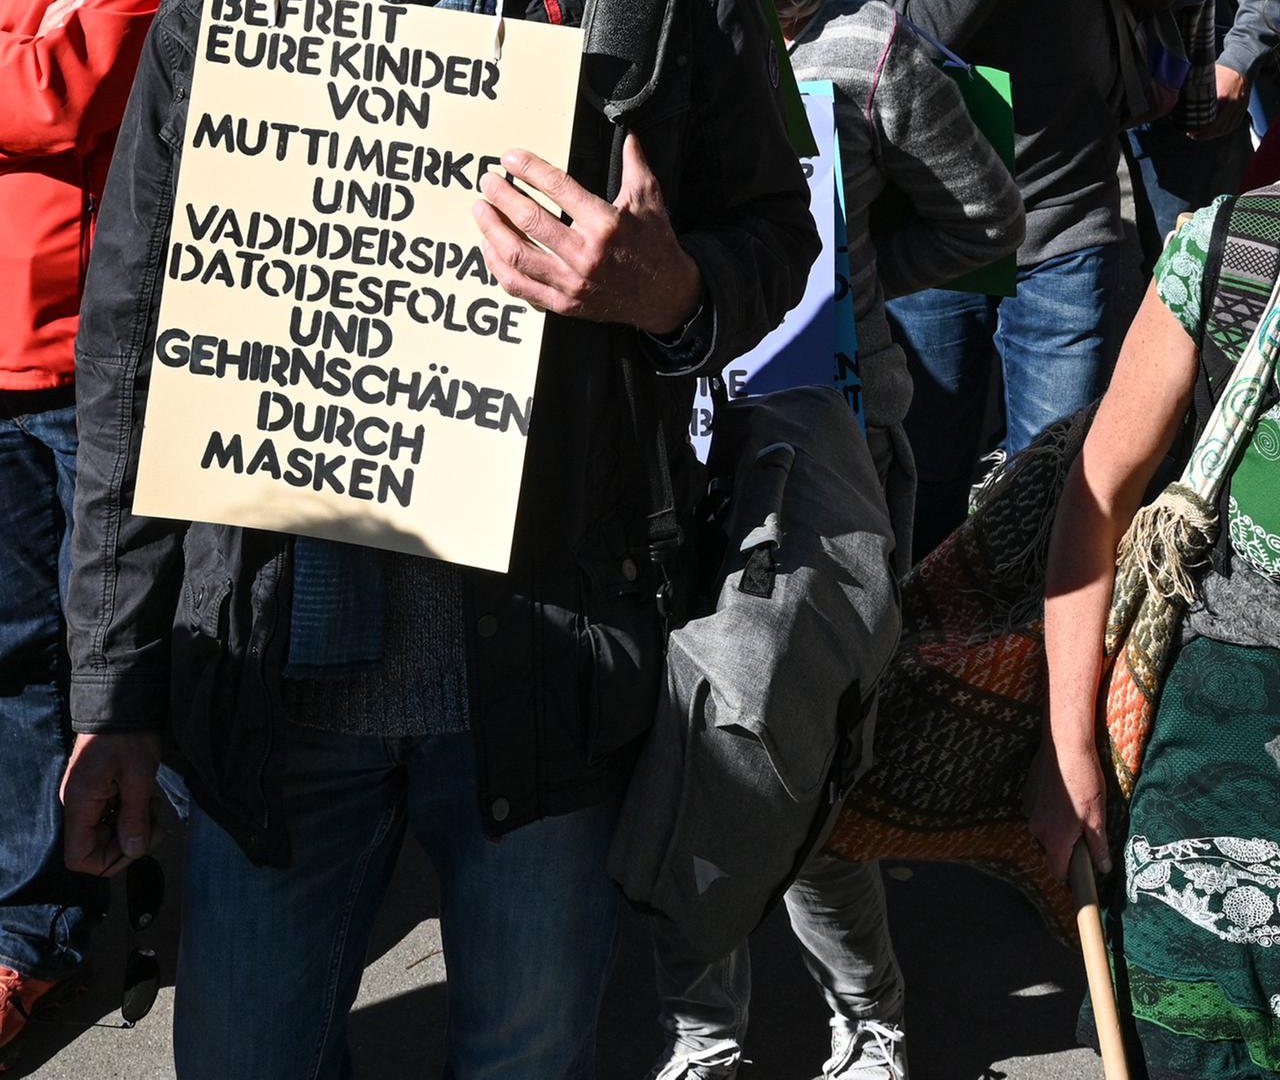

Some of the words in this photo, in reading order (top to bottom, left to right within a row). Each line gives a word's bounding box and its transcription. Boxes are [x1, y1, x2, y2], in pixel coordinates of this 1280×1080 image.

[205, 25, 322, 75] EURE
[331, 41, 500, 100] KINDER
[192, 113, 338, 168] MUTTI
[326, 81, 430, 129] VON
[312, 177, 414, 221] UND
[186, 203, 498, 286] VADDDERSPA
[169, 242, 527, 344] DATODESFOLGE
[290, 307, 393, 358] UND
[156, 328, 533, 437] GEHIRNSCHÄDEN
[257, 391, 425, 465] DURCH
[200, 431, 414, 508] MASKEN
